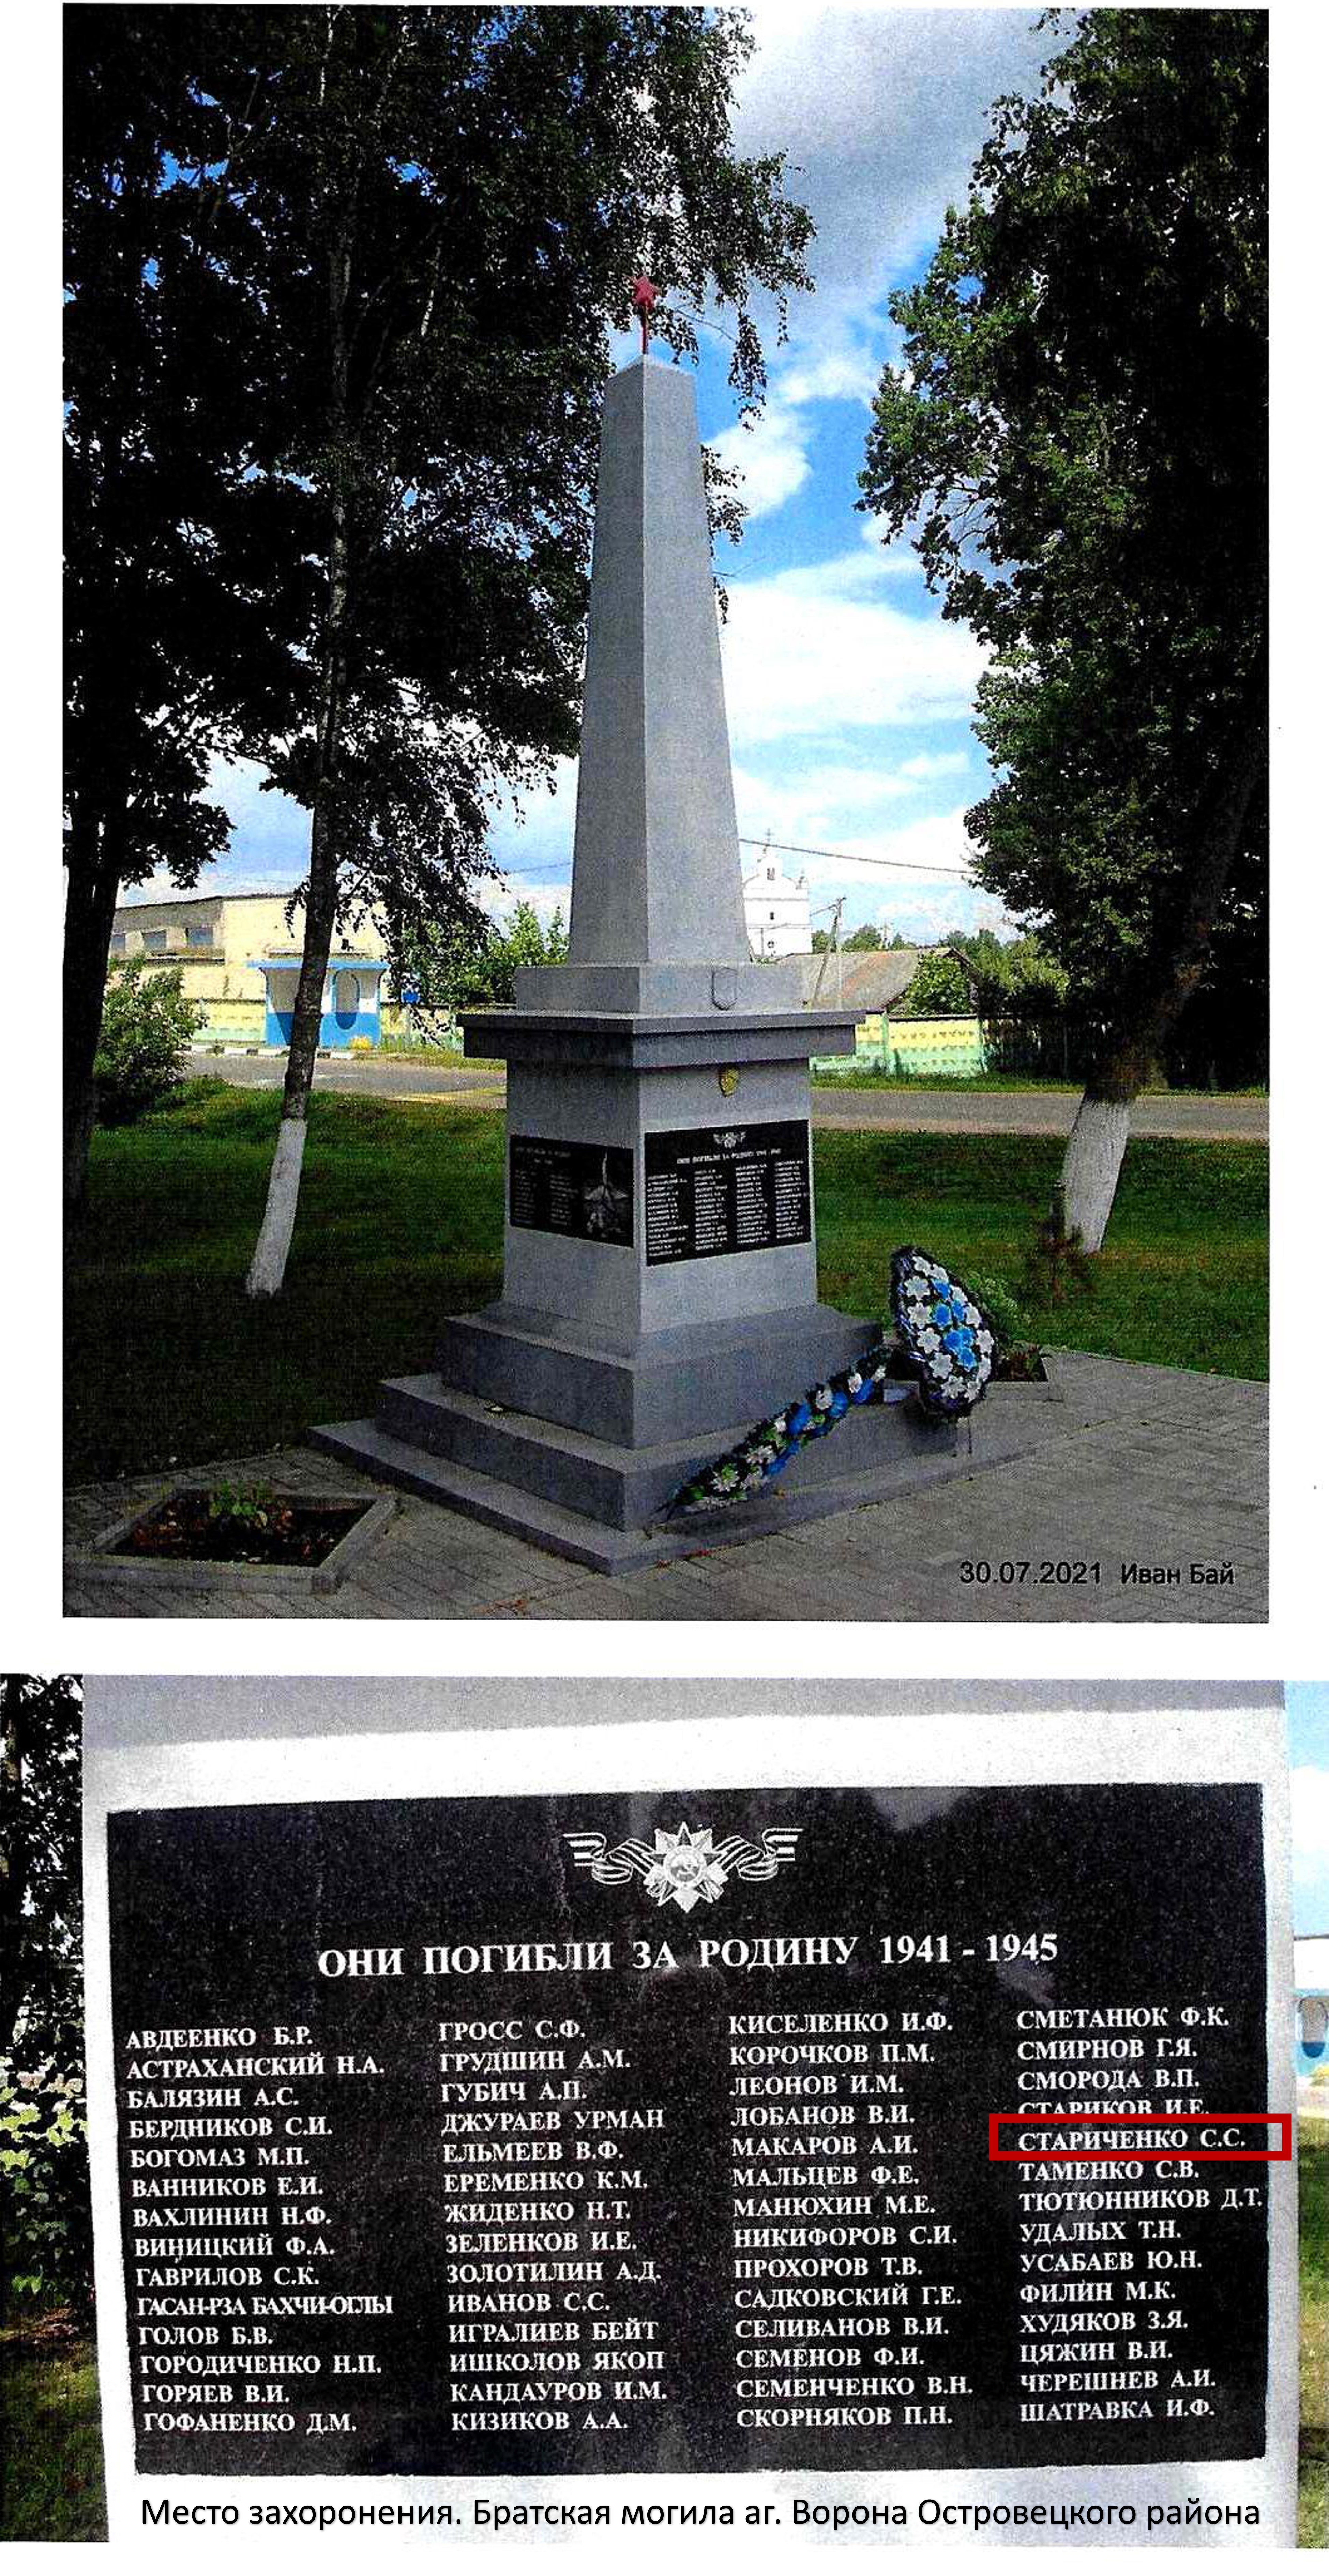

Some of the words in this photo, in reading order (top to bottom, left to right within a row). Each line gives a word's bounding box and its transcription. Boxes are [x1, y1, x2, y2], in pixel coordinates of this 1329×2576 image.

[318, 1948, 404, 1977] ОНИ
[423, 1942, 613, 1974] ПОГИБЛИ
[633, 1941, 679, 1973] ЗА
[699, 1937, 858, 1972] РОДИНУ
[880, 1935, 950, 1963] 1941
[987, 1934, 1057, 1961] 1945
[729, 2013, 888, 2034] КИСЕЛЕНКО
[902, 2012, 952, 2031] И.Ф.
[1017, 2007, 1168, 2029] СМЕТАНЮК
[1181, 2007, 1228, 2025] Ф.К.
[126, 2028, 256, 2052] АВДЕЕНКО
[274, 2026, 312, 2045] Б.Р.
[439, 2021, 522, 2041] ГРОСС
[535, 2020, 585, 2039] С.Ф.
[730, 2045, 868, 2065] КОРОЧКОВ
[881, 2044, 934, 2062] П.М.
[1018, 2040, 1144, 2060] СМИРНОВ
[1157, 2038, 1196, 2057] Г.Я.
[127, 2052, 324, 2078] АСТРАХАНСКИЙ
[337, 2056, 384, 2074] Н.А.
[440, 2051, 565, 2074] ГРУДШИН
[578, 2049, 630, 2069] А.М.
[730, 2076, 837, 2095] ЛЕОНОВ
[850, 2075, 903, 2093] И.М.
[1018, 2070, 1142, 2092] СМОРОДА
[1155, 2069, 1199, 2087] В.П.
[127, 2089, 241, 2108] БАЛЯЗИН
[254, 2087, 298, 2105] А.С.
[441, 2082, 526, 2102] ГУБИЧ
[539, 2081, 587, 2100] А.П.
[441, 2112, 561, 2136] ДЖУРАЕВ
[574, 2110, 663, 2129] УРМАН
[731, 2106, 855, 2127] ЛОБАНОВ
[868, 2105, 914, 2123] В.И.
[130, 2117, 273, 2141] БЕРДНИКОВ
[286, 2117, 332, 2135] С.И.
[1019, 2130, 1188, 2151] СТАРИЧЕНКО
[1200, 2128, 1245, 2147] С.С.
[443, 2142, 563, 2162] ЕЛЬМЕЕВ
[576, 2141, 623, 2159] В.Ф.
[732, 2136, 857, 2156] МАКАРОВ
[870, 2135, 918, 2154] А.И.
[131, 2148, 245, 2167] БОГОМАЗ
[258, 2147, 309, 2165] М.П.
[444, 2172, 583, 2192] ЕРЕМЕНКО
[596, 2171, 647, 2189] К.М.
[733, 2167, 857, 2189] МАЛЬЦЕВ
[871, 2166, 918, 2184] Ф.Е.
[1019, 2161, 1143, 2181] ТАМЕНКО
[1156, 2161, 1198, 2178] С.В.
[133, 2178, 266, 2197] ВАННИКОВ
[278, 2177, 323, 2195] Е.И.
[734, 2197, 872, 2216] МАНЮХИН
[886, 2195, 935, 2214] М.Е.
[1019, 2190, 1210, 2211] ТЮТЮННИКОВ
[1221, 2188, 1262, 2210] Д.Т.
[133, 2208, 267, 2227] ВАХЛИНИН
[281, 2207, 331, 2224] Н.Ф.
[444, 2202, 574, 2226] ЖИДЕНКО
[587, 2201, 630, 2219] Н.Т.
[446, 2233, 578, 2253] ЗЕЛЕНКОВ
[590, 2231, 636, 2250] И.Е.
[734, 2227, 896, 2247] НИКИФОРОВ
[910, 2226, 956, 2244] С.И.
[1020, 2222, 1126, 2245] УДАЛЫХ
[1138, 2220, 1180, 2238] Т.Н.
[135, 2233, 273, 2260] ВИНИЦКИЙ
[286, 2237, 335, 2254] Ф.А.
[735, 2258, 868, 2278] ПРОХОРОВ
[881, 2257, 922, 2275] Т.В.
[1021, 2252, 1133, 2272] УСАБАЕВ
[1148, 2251, 1201, 2268] Ю.Н.
[136, 2268, 262, 2286] ГАВРИЛОВ
[274, 2267, 319, 2285] С.К.
[447, 2262, 603, 2283] ЗОЛОТИЛИН
[616, 2262, 661, 2283] А.Д.
[735, 2283, 908, 2310] САДКОВСКИЙ
[922, 2287, 961, 2304] Г.Е.
[1021, 2280, 1113, 2302] ФИЛИН
[1127, 2282, 1175, 2300] М.К.
[138, 2298, 246, 2315] ГАСАН-РЗА
[252, 2296, 393, 2314] БАХЧИ-ОГЛЫ
[449, 2294, 551, 2312] ИВАНОВ
[564, 2292, 609, 2311] С.С.
[449, 2323, 579, 2342] ИГРАЛИЕВ
[592, 2318, 658, 2340] БЕЙТ
[736, 2318, 890, 2338] СЕЛИВАНОВ
[904, 2317, 948, 2335] В.И.
[1020, 2312, 1135, 2335] ХУДЯКОВ
[1149, 2311, 1187, 2329] З.Я.
[139, 2327, 218, 2345] ГОЛОВ
[232, 2327, 272, 2344] Б.В.
[451, 2352, 580, 2372] ИШКОЛОВ
[592, 2352, 664, 2370] ЯКОП
[736, 2349, 861, 2368] СЕМЕНОВ
[874, 2347, 924, 2365] Ф.И.
[1021, 2343, 1114, 2365] ЦЯЖИН
[1129, 2341, 1172, 2359] В.И.
[141, 2356, 321, 2376] ГОРОДИЧЕНКО
[334, 2355, 381, 2373] Н.П.
[737, 2378, 914, 2397] СЕМЕНЧЕНКО
[928, 2377, 972, 2394] В.Н.
[1021, 2371, 1158, 2392] ЧЕРЕШНЕВ
[1171, 2370, 1215, 2388] А.И.
[143, 2385, 233, 2402] ГОРЯЕВ
[246, 2385, 289, 2402] В.И.
[450, 2382, 601, 2404] КАНДАУРОВ
[615, 2382, 666, 2399] И.М.
[737, 2407, 891, 2427] СКОРНЯКОВ
[904, 2406, 952, 2424] П.Н.
[1021, 2401, 1153, 2421] ШАТРАВКА
[1167, 2399, 1214, 2416] И.Ф.
[144, 2413, 295, 2431] ГОФАНЕНКО
[307, 2414, 356, 2435] Д.М.
[452, 2412, 569, 2430] КИЗИКОВ
[583, 2412, 627, 2429] А.А.
